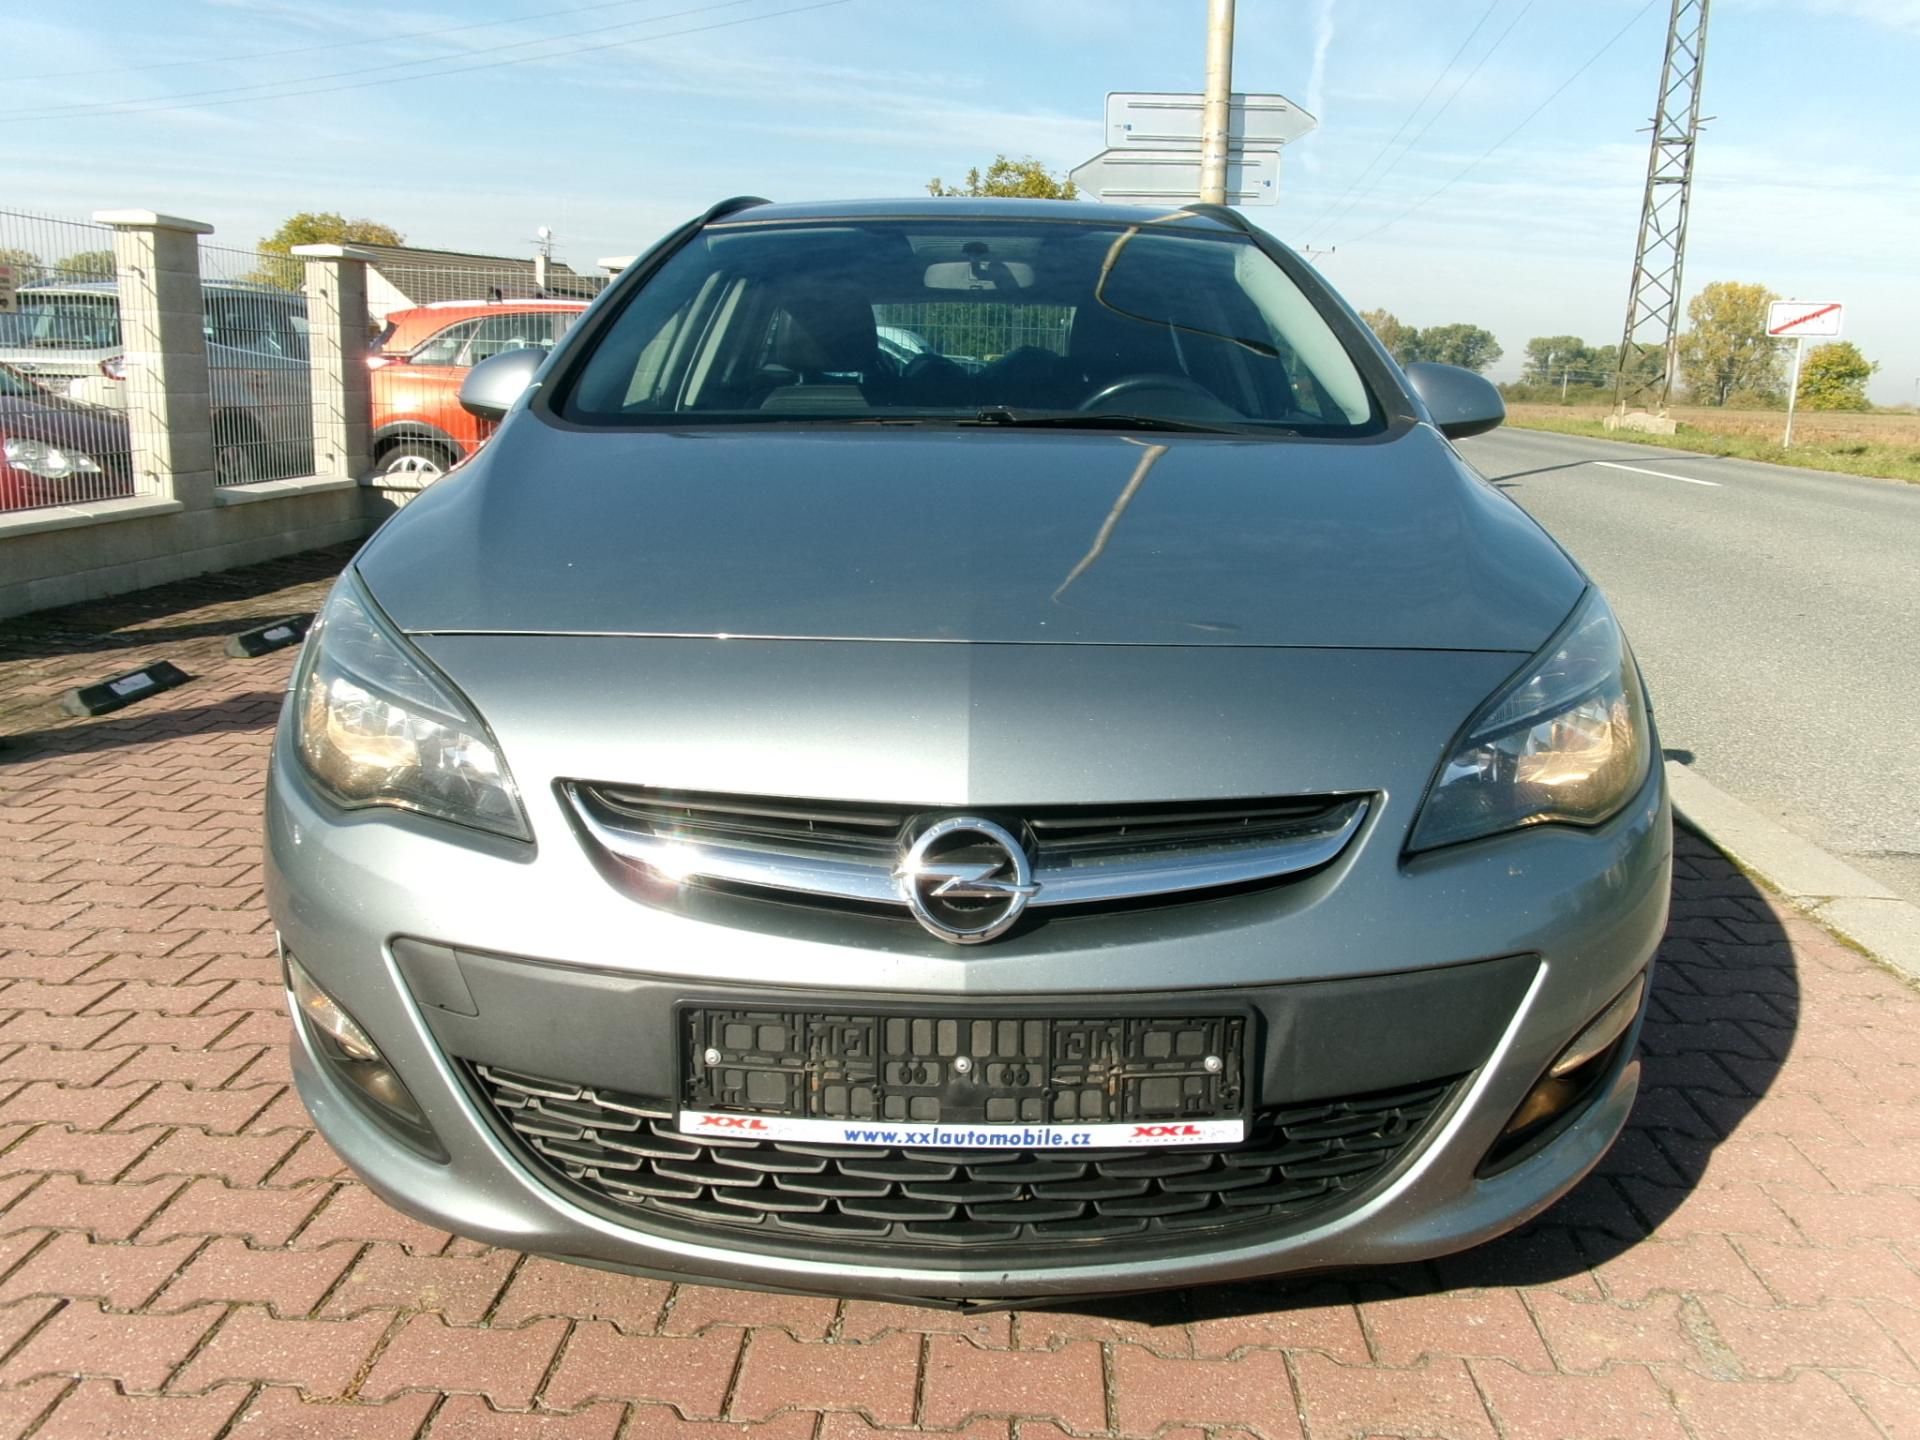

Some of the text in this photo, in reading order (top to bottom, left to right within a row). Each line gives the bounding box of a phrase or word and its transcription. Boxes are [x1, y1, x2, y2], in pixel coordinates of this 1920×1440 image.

[697, 1115, 768, 1130] XXL
[844, 1127, 1091, 1146] www.xxlautomobile.cz
[1131, 1125, 1201, 1137] XXL
